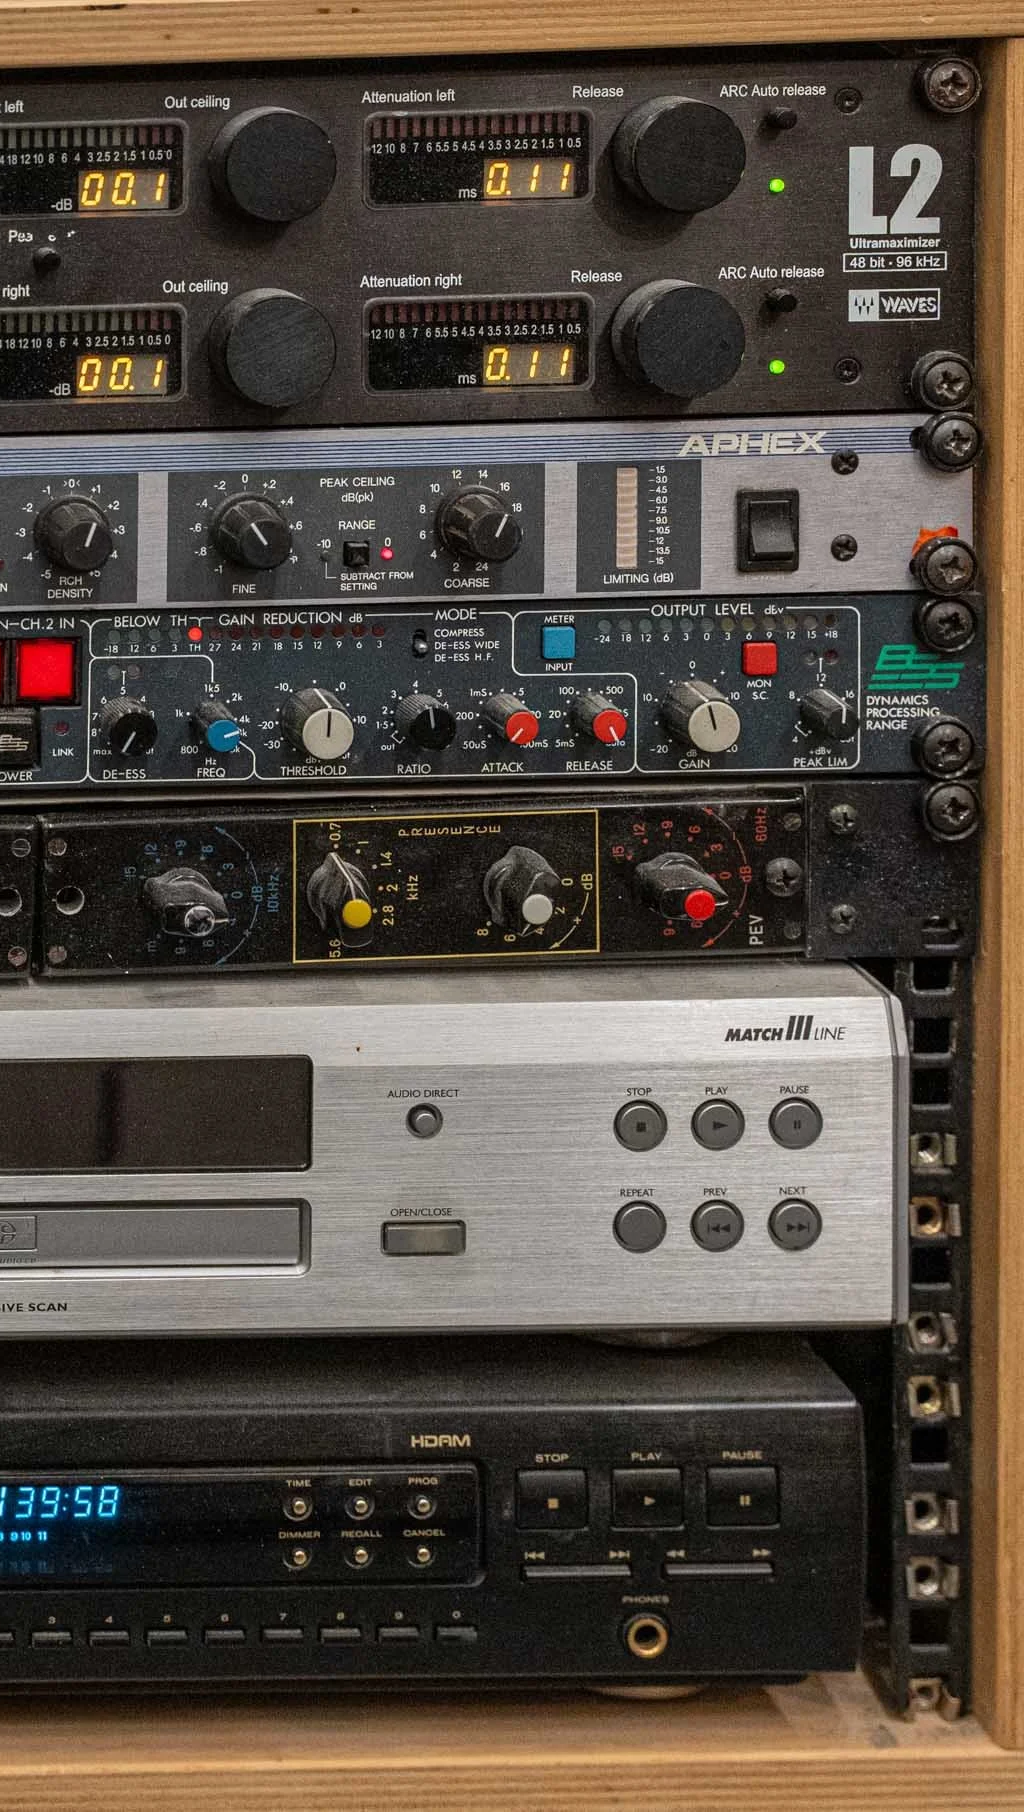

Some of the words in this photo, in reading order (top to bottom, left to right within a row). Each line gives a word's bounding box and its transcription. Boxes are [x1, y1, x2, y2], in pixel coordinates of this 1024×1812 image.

[572, 85, 624, 98] Release
[720, 84, 748, 97] ARC
[751, 84, 779, 97] Auto
[781, 83, 826, 96] release
[362, 90, 429, 103] Attenuation
[433, 89, 455, 102] left
[4, 101, 24, 114] left
[164, 96, 186, 109] Out
[190, 95, 230, 110] ceiling
[486, 163, 571, 195] 0.11
[81, 173, 165, 205] 00.1
[848, 143, 943, 235] L2
[850, 237, 941, 249] Ultramaximizer
[850, 256, 866, 268] 48
[870, 256, 885, 268] bit
[896, 255, 912, 267] 96
[916, 255, 941, 267] kHz
[361, 275, 428, 288] Attenuation
[432, 273, 462, 288] right
[2, 285, 30, 299] right
[882, 295, 936, 314] WAVES
[678, 431, 826, 457] APHEX
[319, 477, 349, 487] PEAK
[353, 476, 395, 486] CEILING
[338, 520, 376, 530] RANGE
[341, 572, 386, 581] SUBTRACT
[389, 571, 414, 580] FROM
[603, 573, 648, 584] LIMITING
[653, 572, 674, 584] (dB)
[233, 583, 256, 593] FINE
[340, 582, 377, 591] SETTING
[444, 578, 490, 588] COARSE
[866, 696, 928, 706] DYNAMICS
[866, 708, 940, 718] PROCESSING
[866, 720, 908, 730] RANGE
[814, 1026, 848, 1040] LINE
[387, 1089, 420, 1099] AUDIO
[423, 1088, 459, 1098] DIRECT
[626, 1087, 652, 1096] STOP
[705, 1087, 728, 1095] PLAY
[779, 1085, 809, 1094] PAUSE
[620, 1188, 654, 1197] REPEAT
[703, 1187, 727, 1196] PREV
[779, 1186, 806, 1195] NEXT
[390, 1207, 452, 1217] OPEN/CLOSE
[28, 1302, 68, 1312] SCAN
[535, 1454, 568, 1463] STOP
[631, 1452, 662, 1461] PLAY
[722, 1451, 762, 1460] PAUSE
[286, 1479, 311, 1487] TIME
[348, 1479, 372, 1487] EDIT
